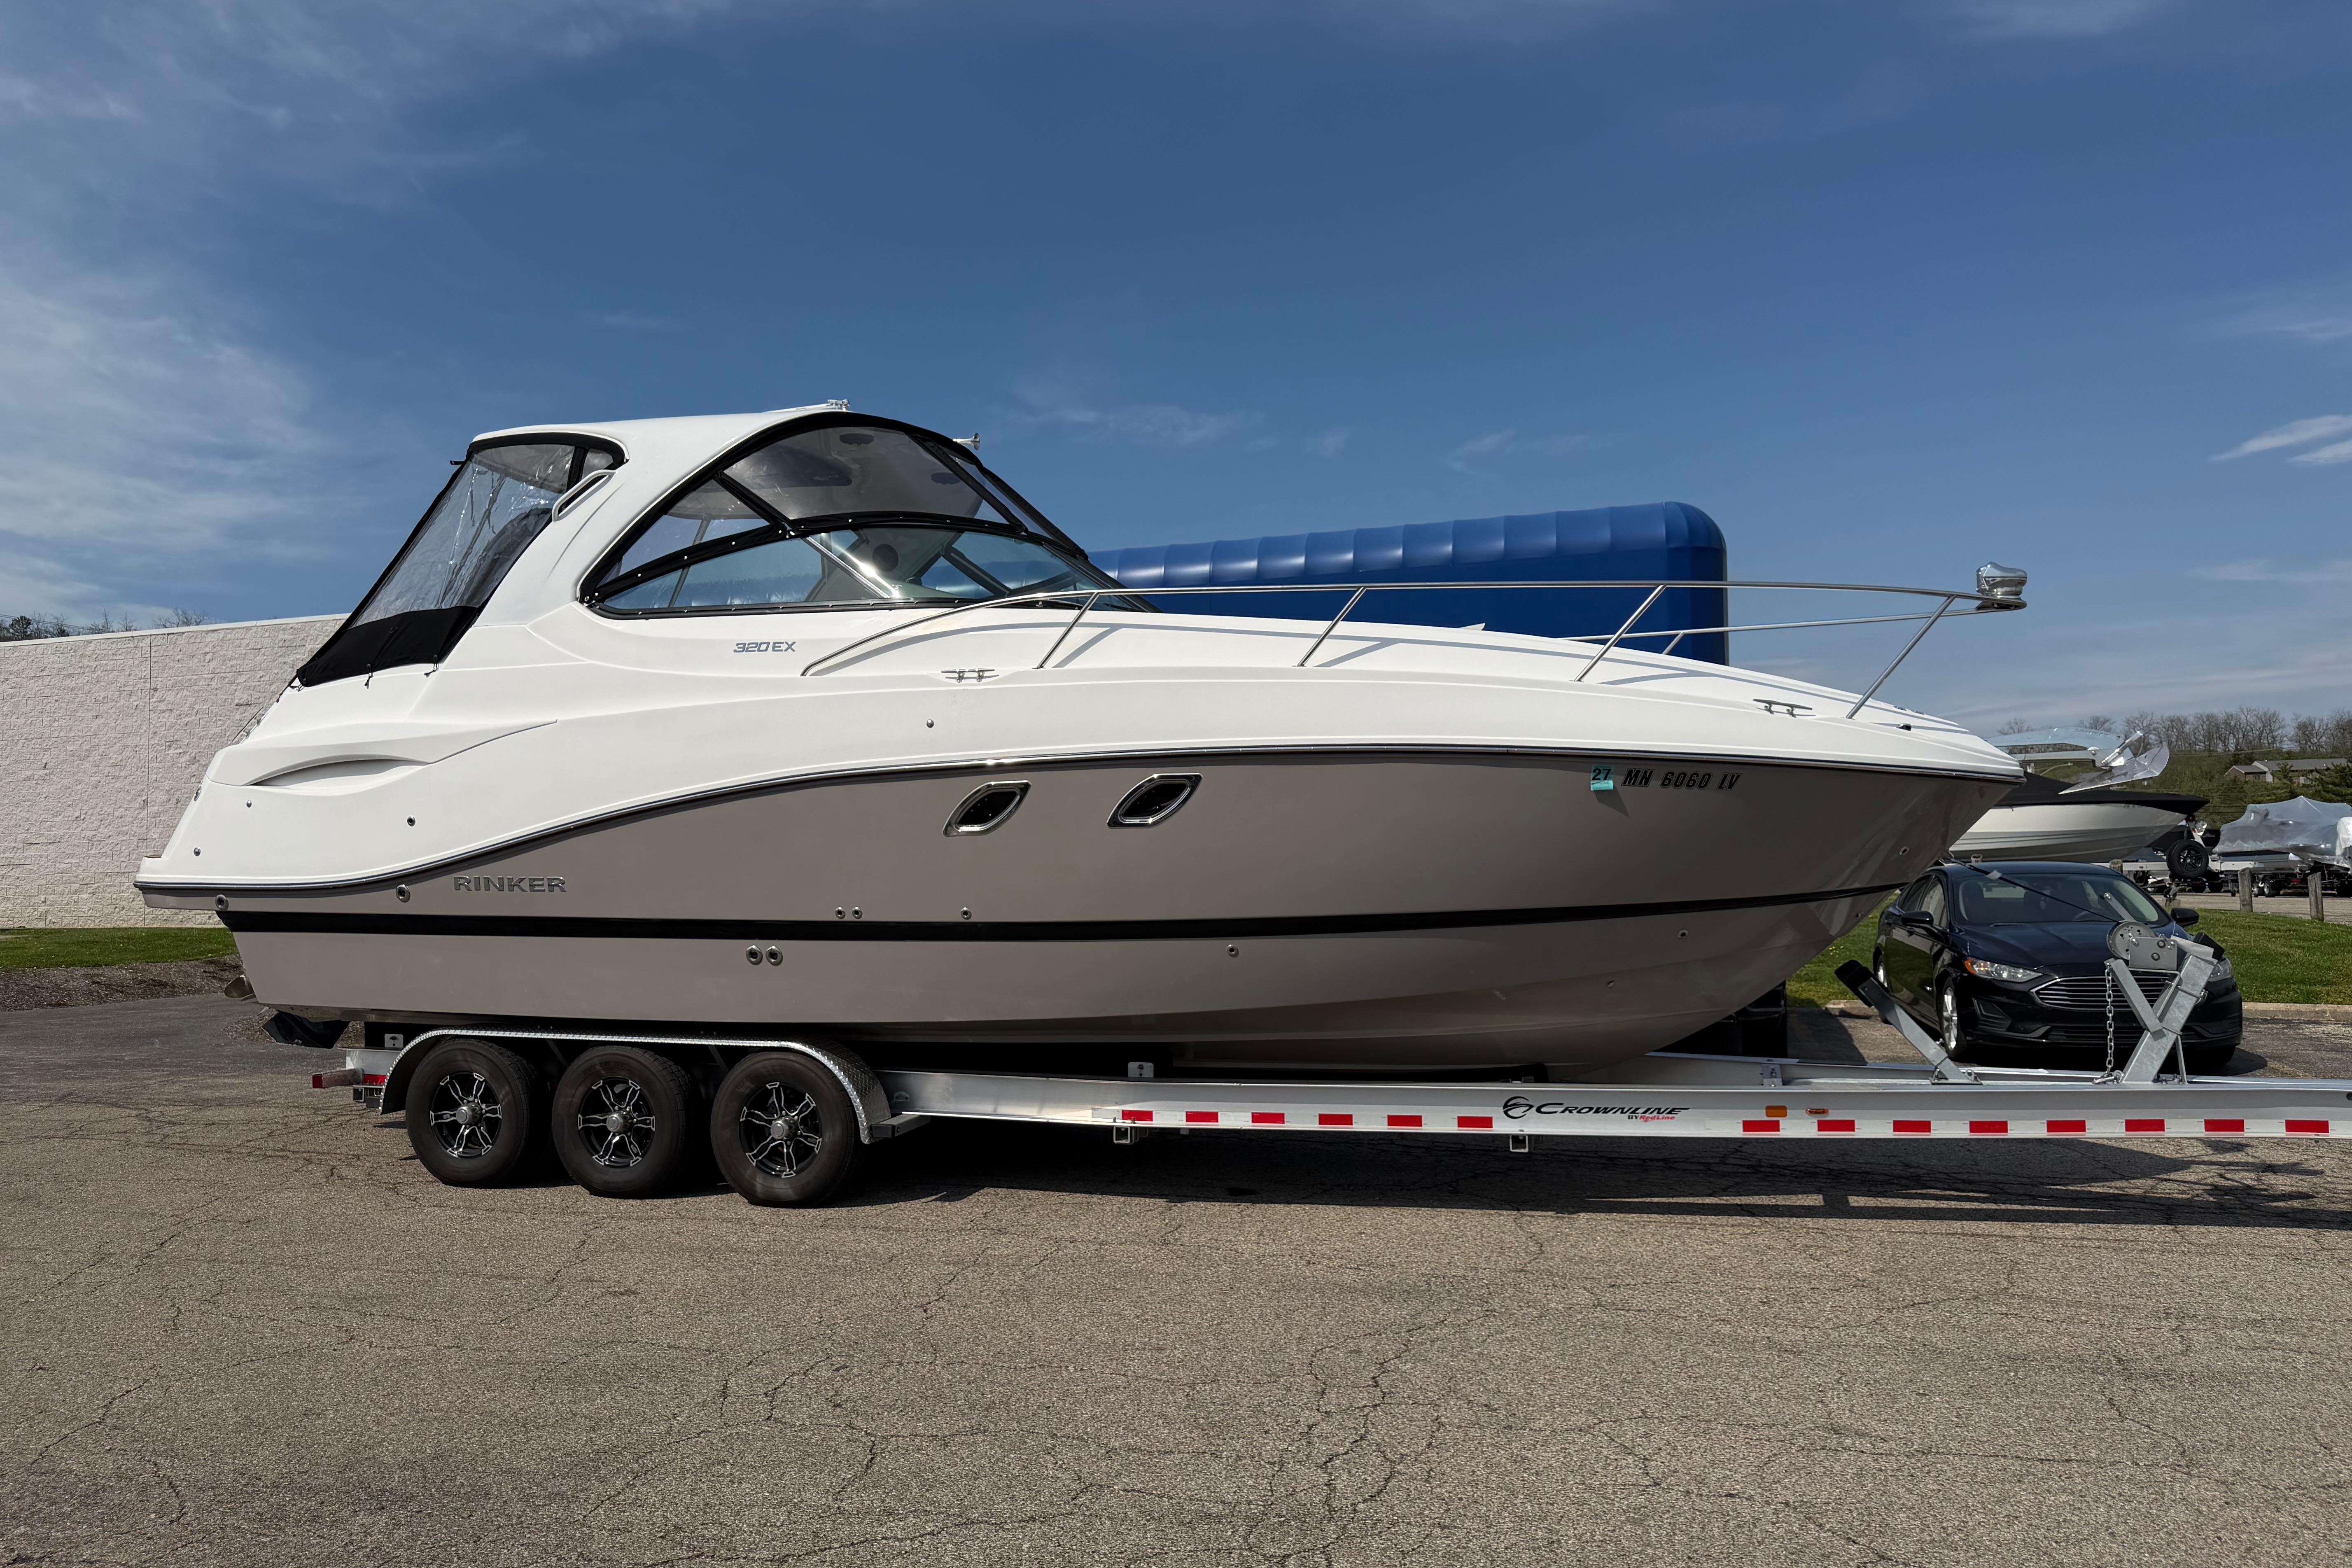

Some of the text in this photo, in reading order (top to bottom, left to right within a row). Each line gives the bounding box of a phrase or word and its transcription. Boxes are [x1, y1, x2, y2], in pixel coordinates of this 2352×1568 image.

[1592, 768, 1612, 781] 27
[1621, 768, 1743, 790] MN 6060 LV
[453, 876, 567, 892] RINKER
